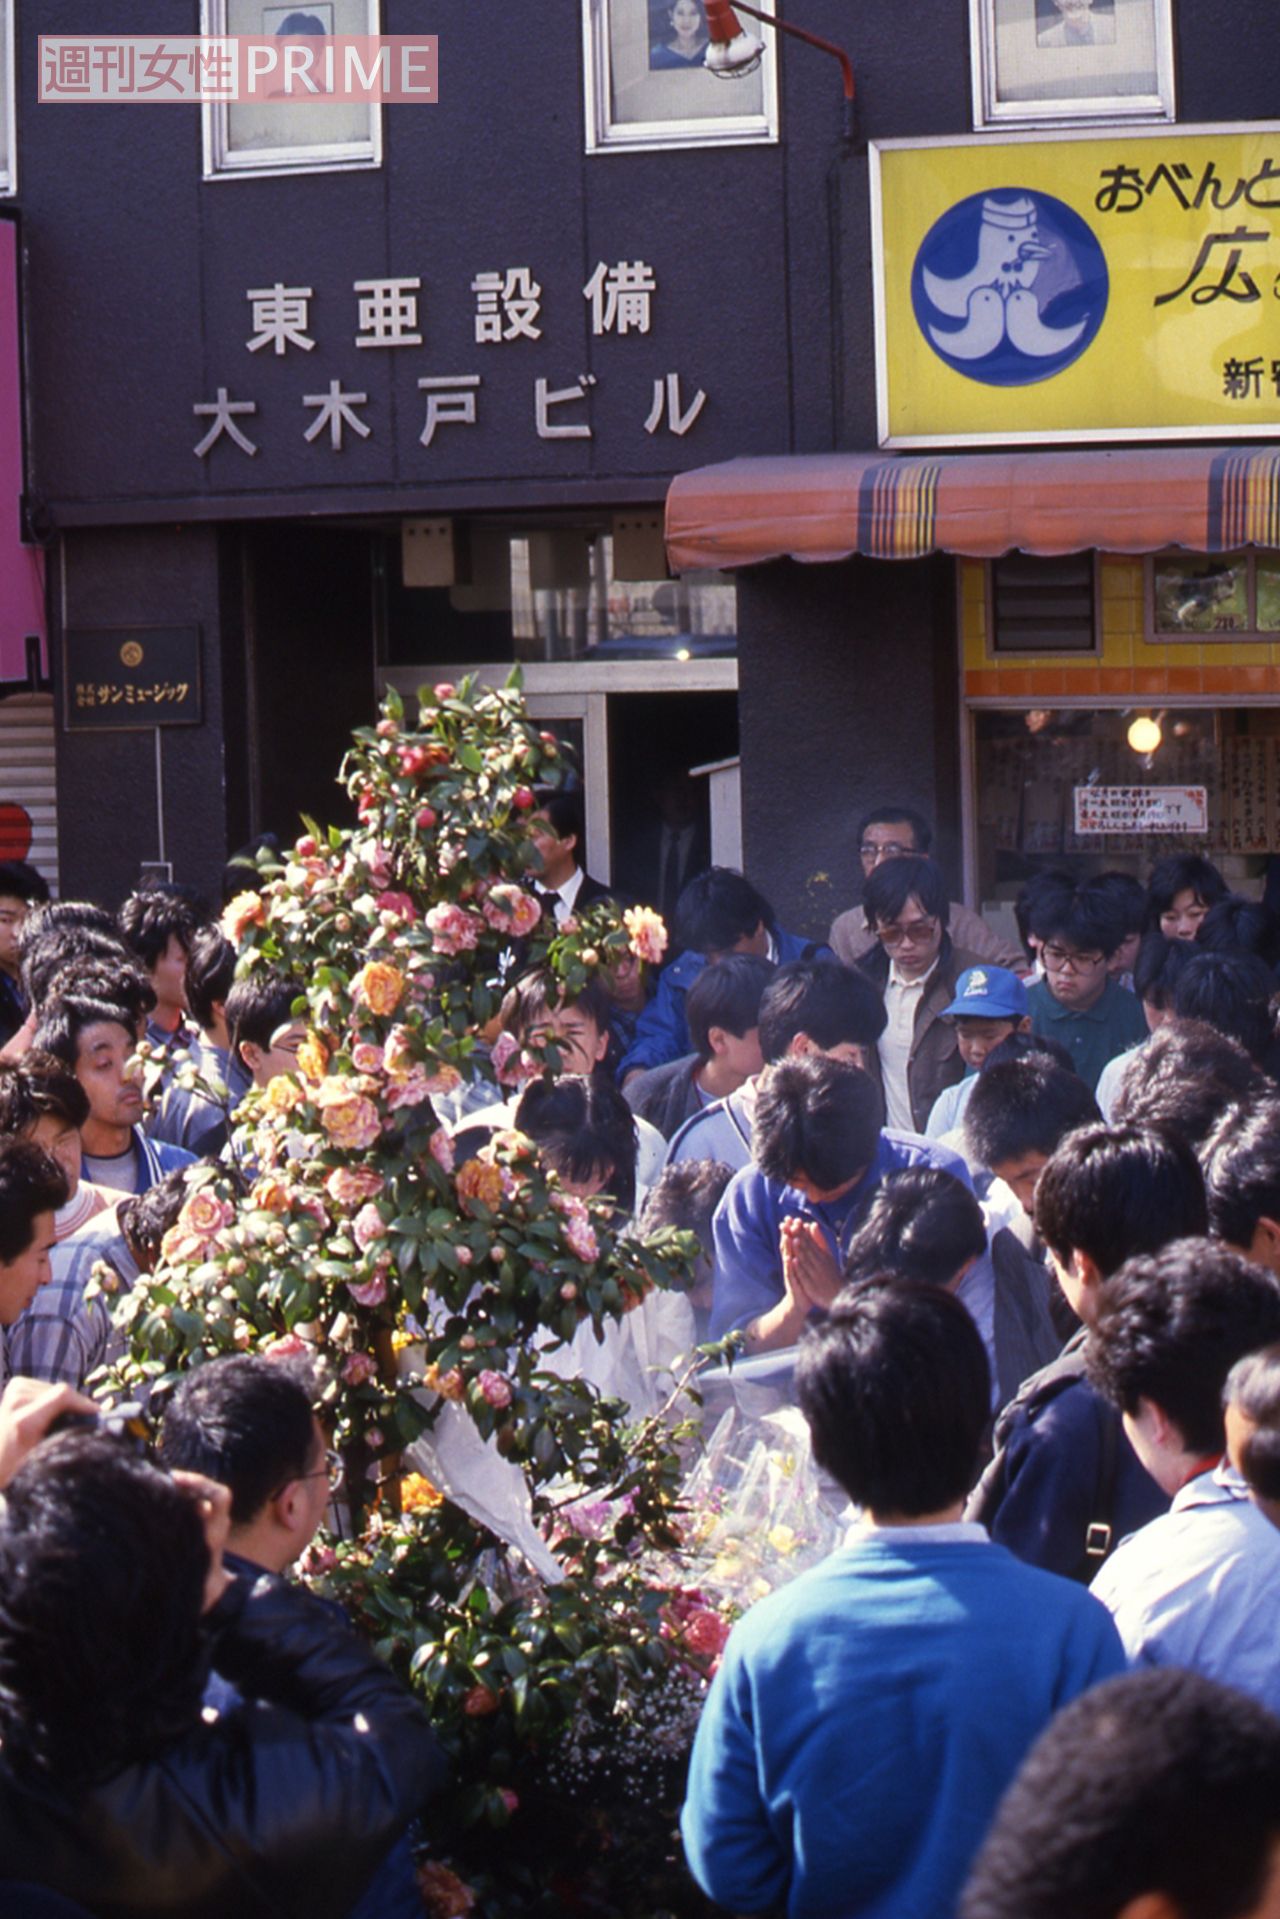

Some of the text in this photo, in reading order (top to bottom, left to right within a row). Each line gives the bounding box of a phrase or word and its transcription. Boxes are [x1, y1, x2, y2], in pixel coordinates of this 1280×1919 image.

[245, 260, 656, 355] 東亜設備
[1153, 226, 1280, 307] 広
[192, 373, 706, 457] 大木戸ビル
[1223, 356, 1280, 400] 新
